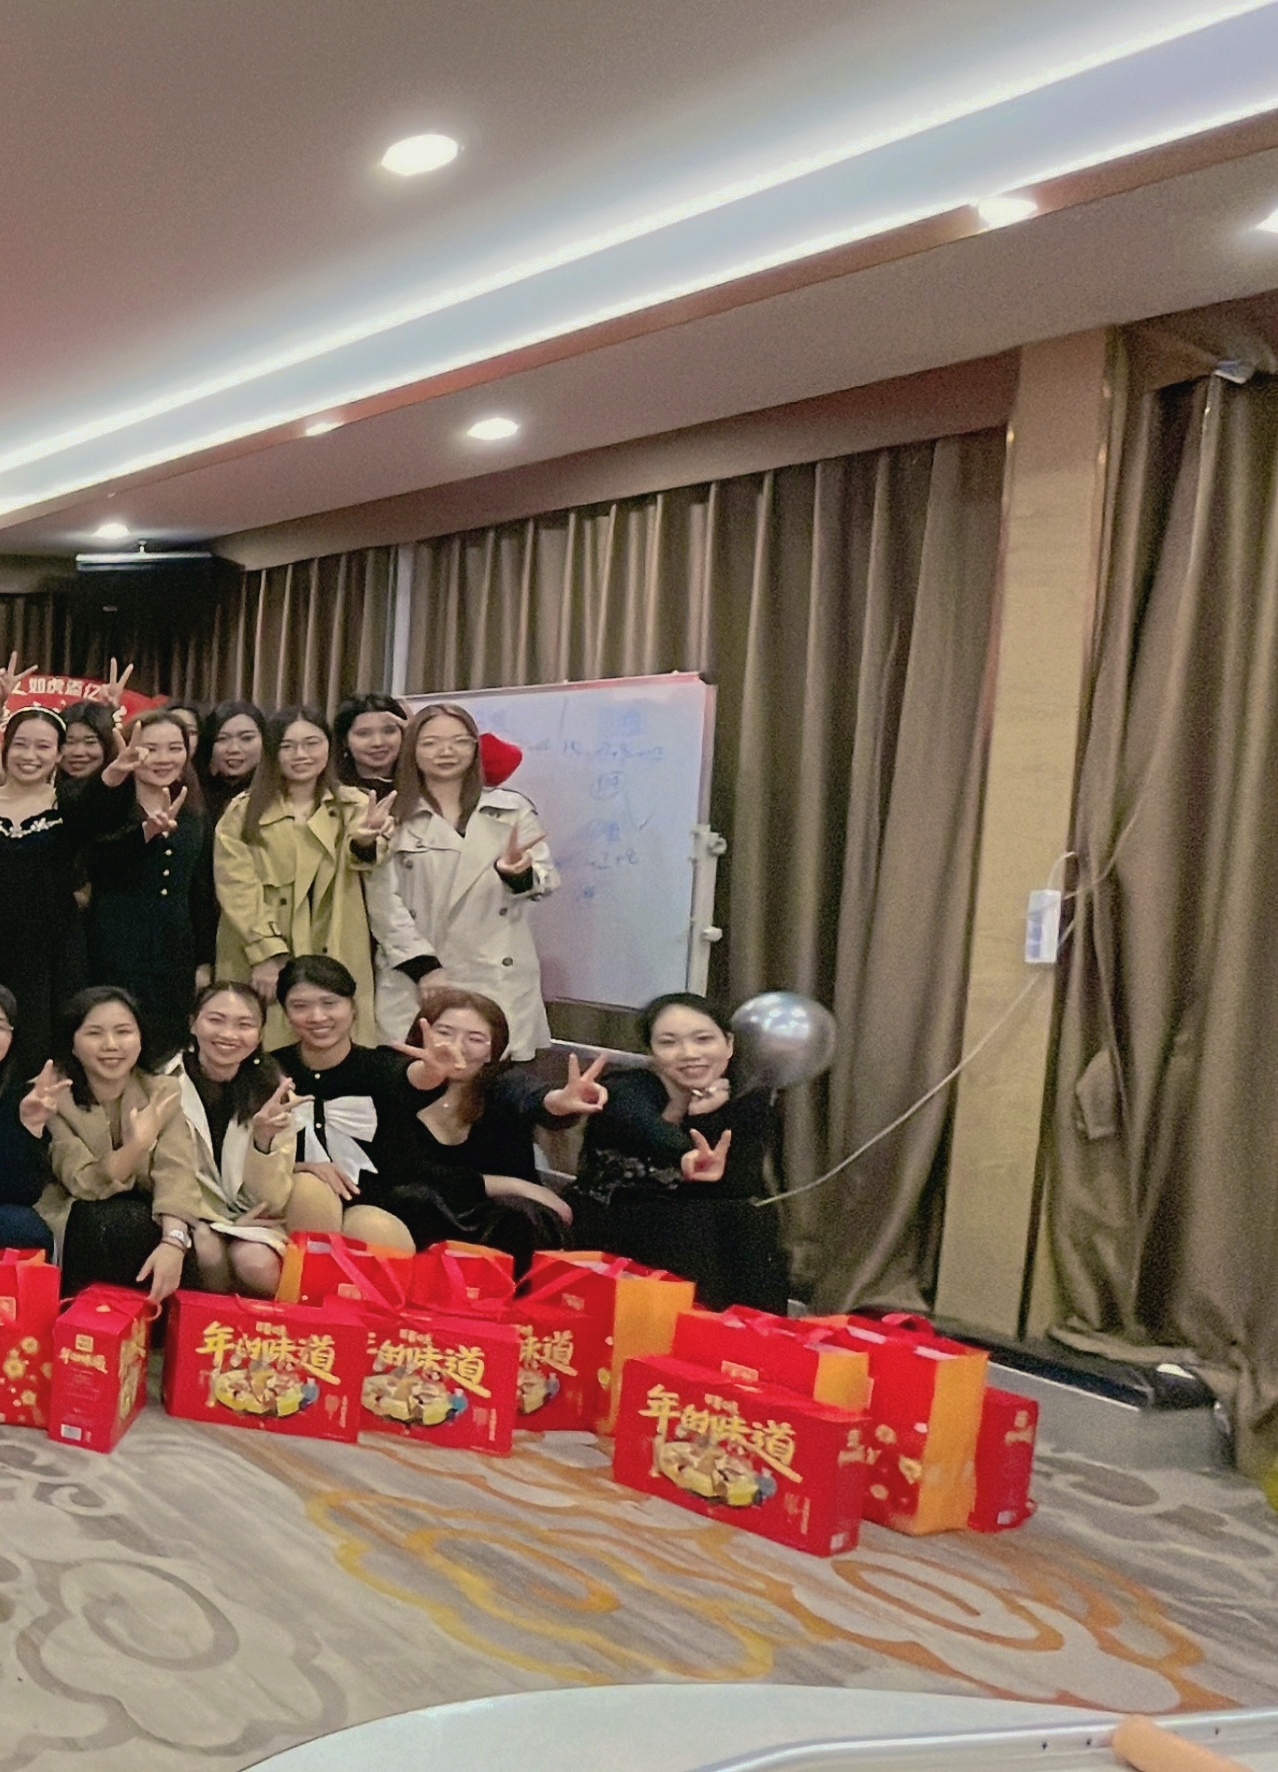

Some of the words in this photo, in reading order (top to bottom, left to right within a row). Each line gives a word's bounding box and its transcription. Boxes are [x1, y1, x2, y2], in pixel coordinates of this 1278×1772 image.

[195, 1321, 341, 1386] 年的味道
[366, 1331, 492, 1398] 的味道
[637, 1384, 803, 1483] 年的味道
